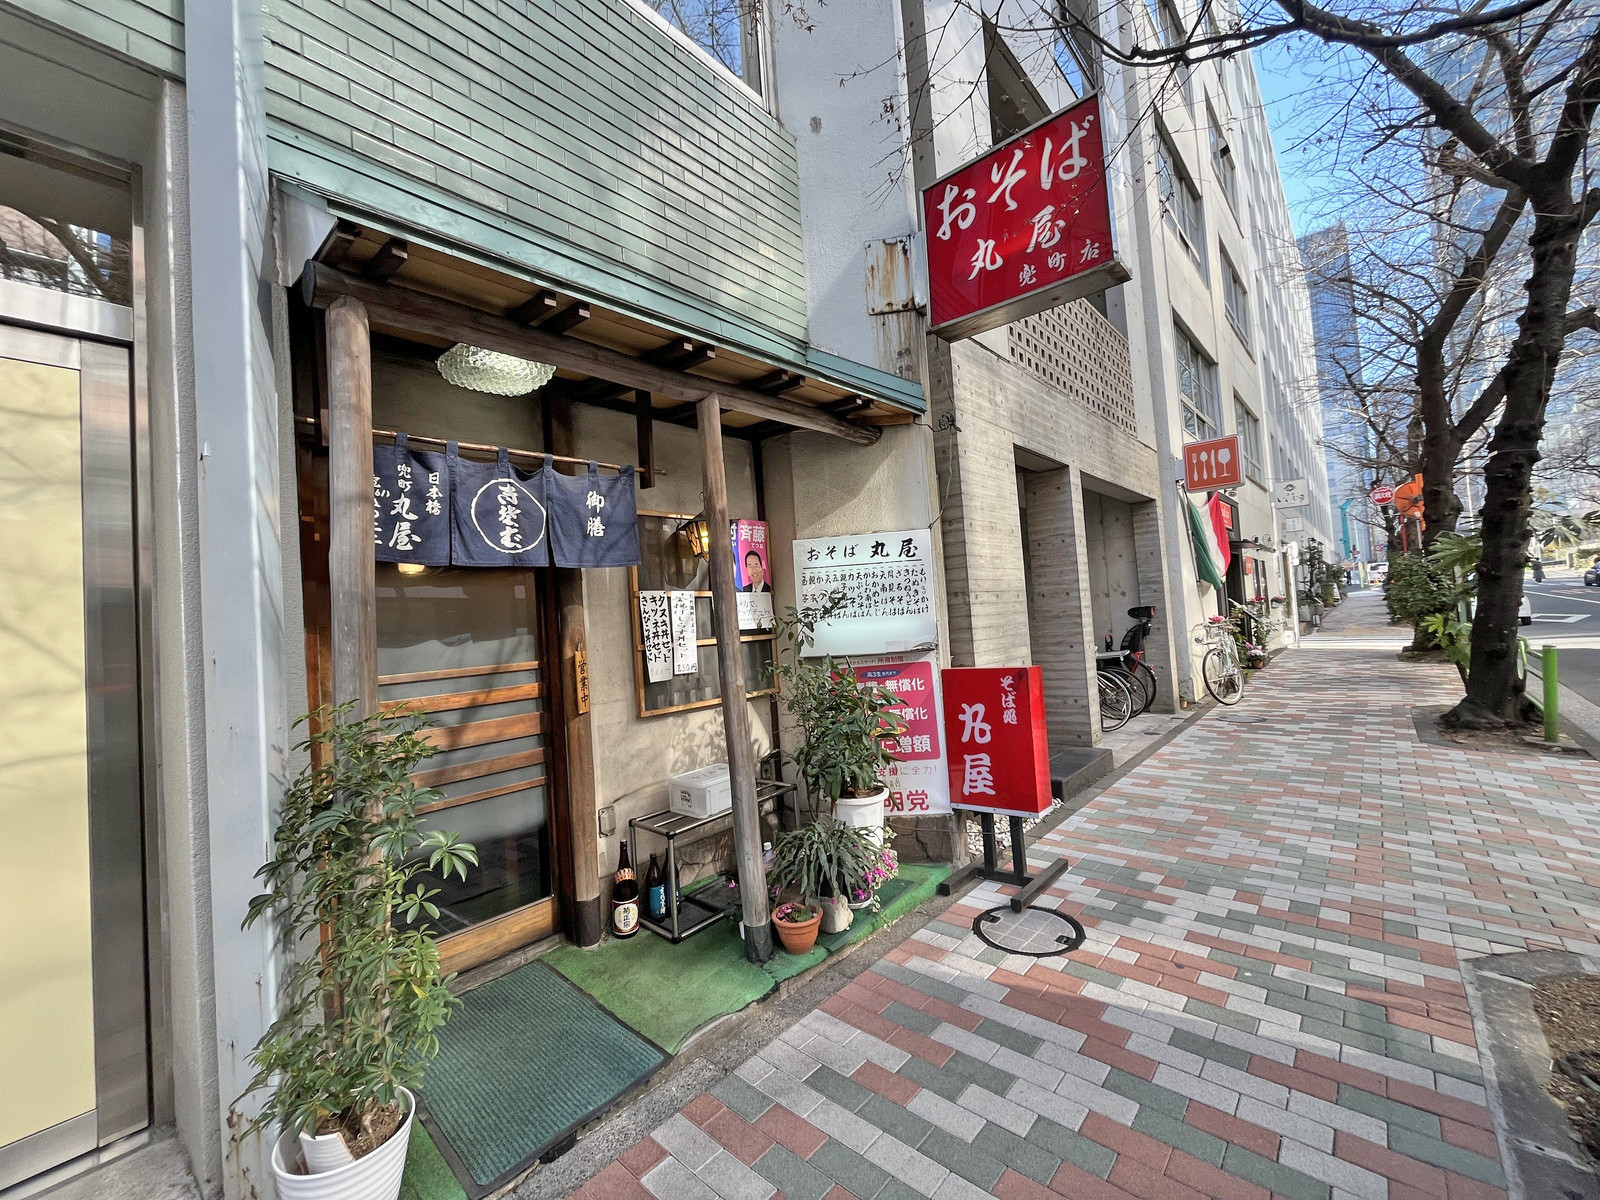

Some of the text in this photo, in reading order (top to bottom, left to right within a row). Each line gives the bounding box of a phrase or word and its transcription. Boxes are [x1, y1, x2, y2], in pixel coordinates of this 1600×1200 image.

[936, 114, 1095, 242] おそば
[967, 203, 1066, 282] 丸屋
[425, 471, 443, 516] 日本橋
[585, 490, 606, 538] 御膳
[577, 658, 589, 709] 営業中
[957, 702, 996, 797] 丸屋
